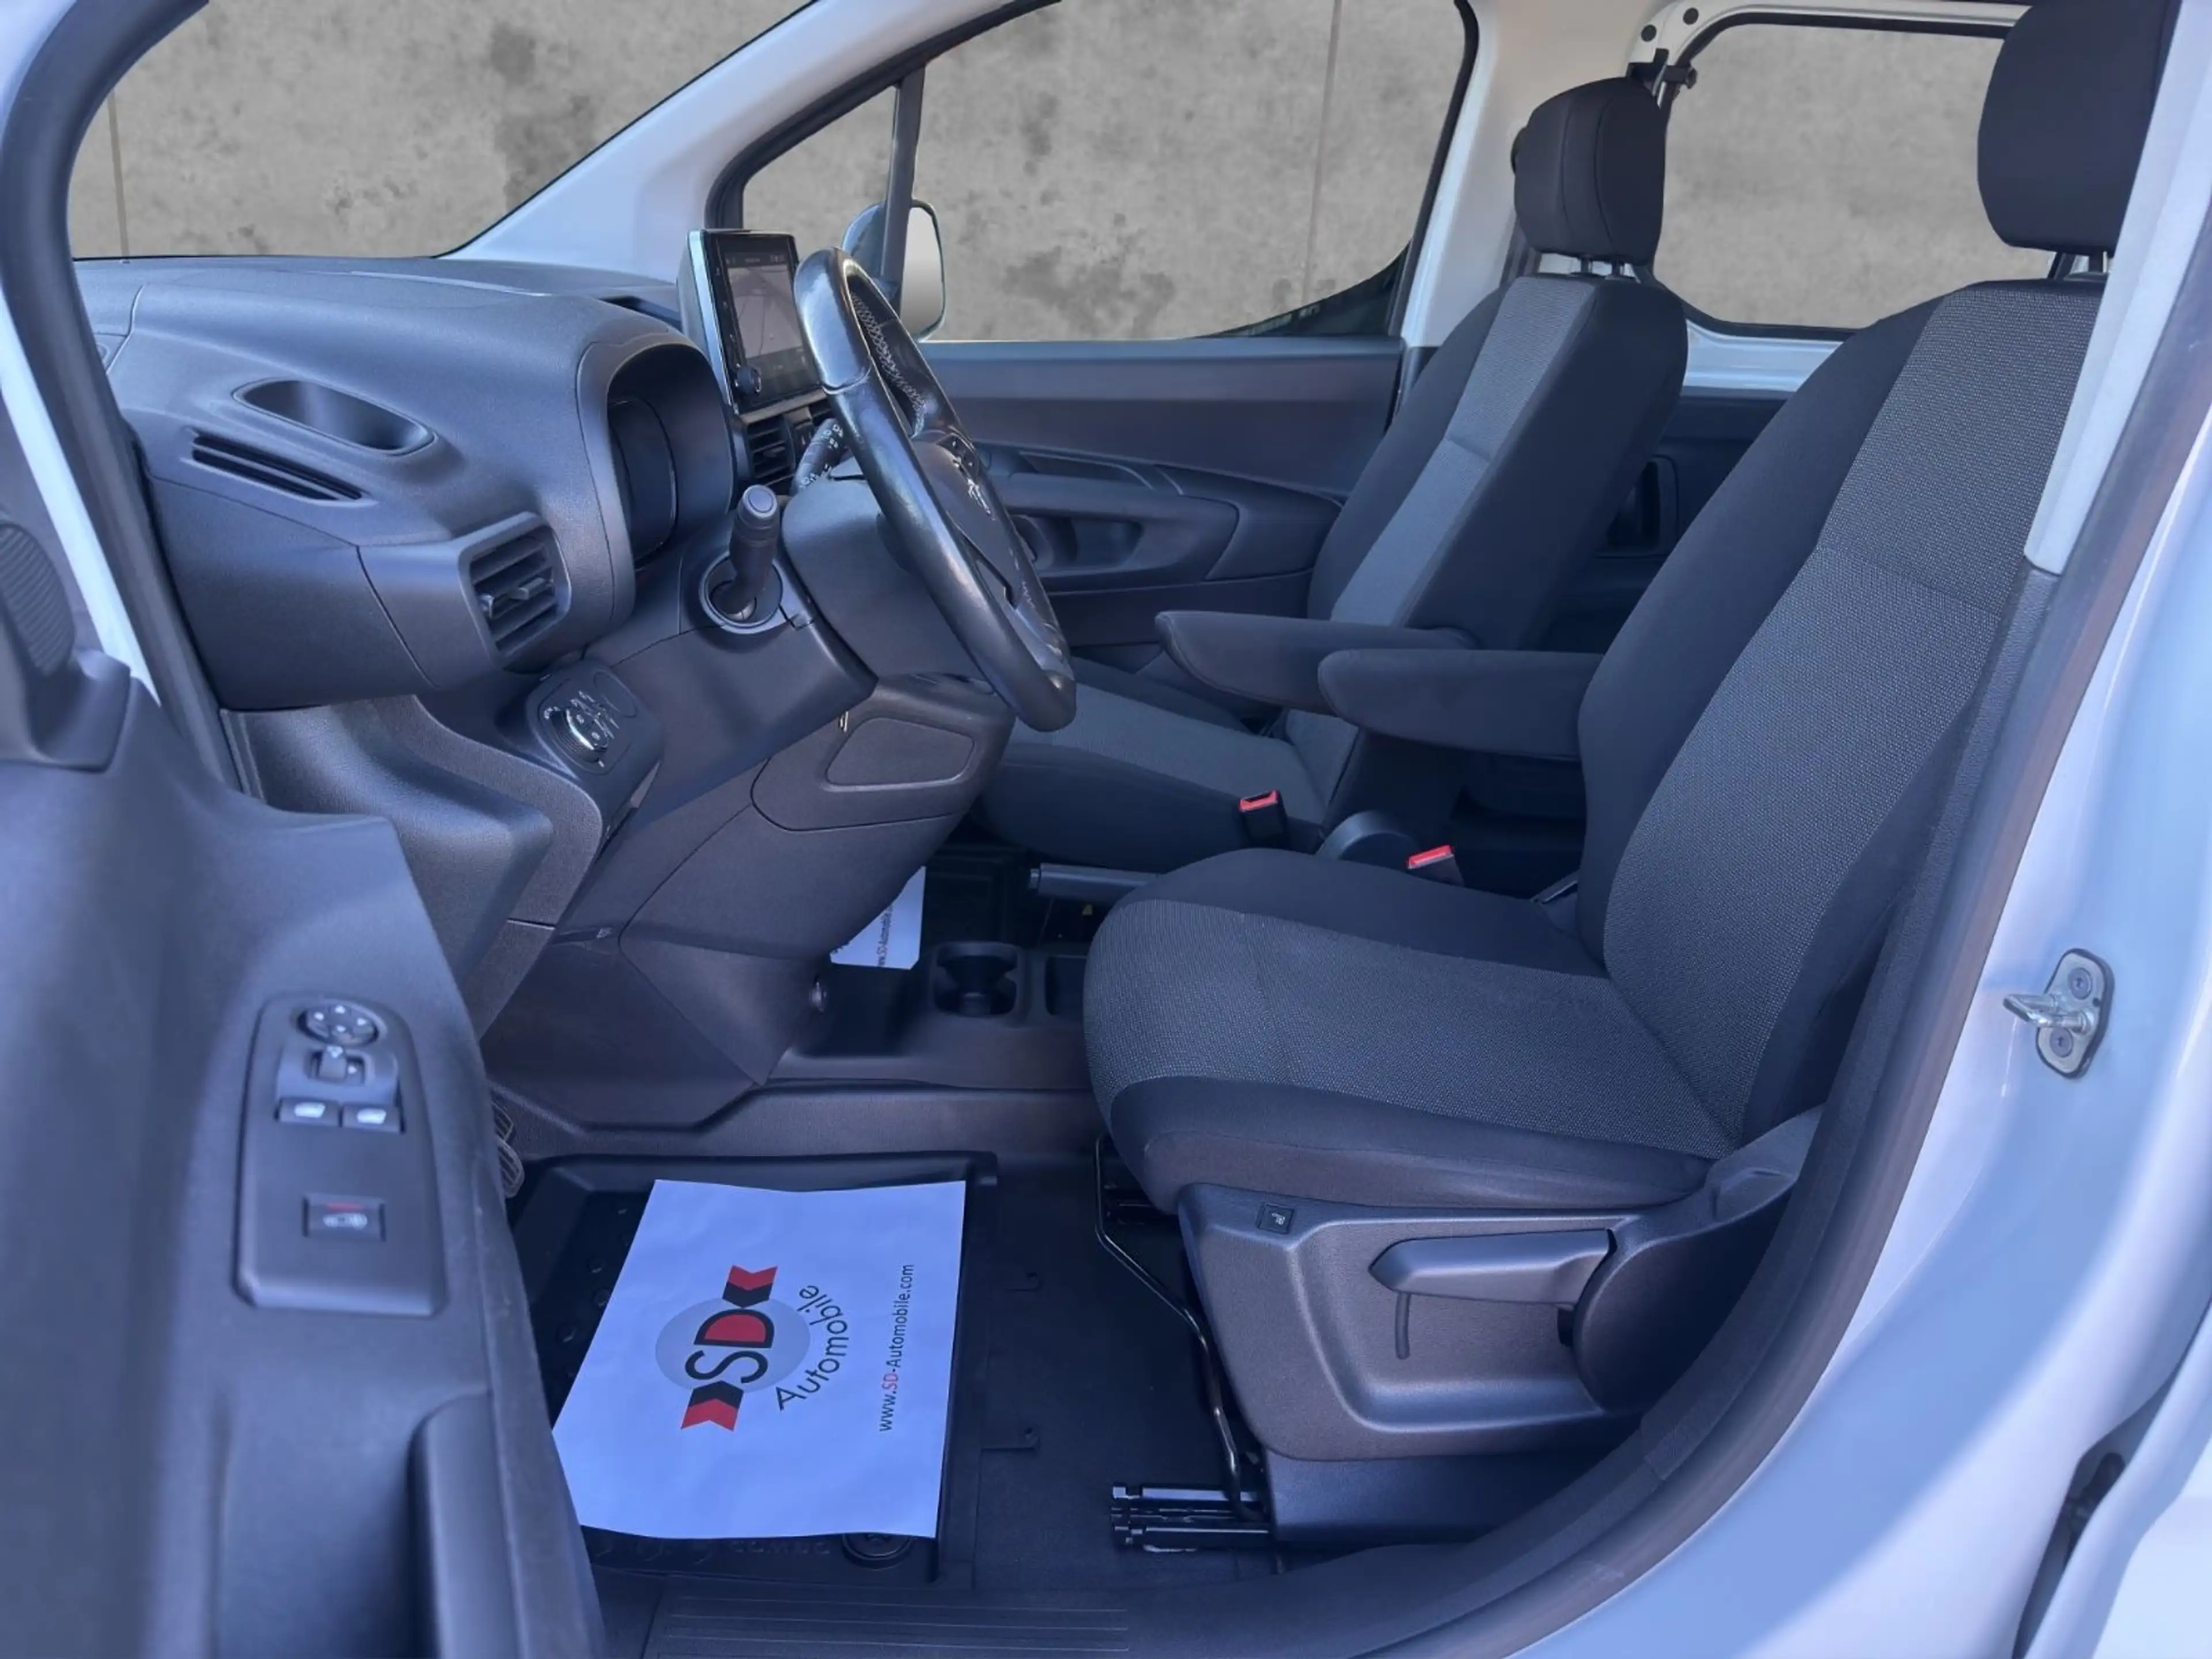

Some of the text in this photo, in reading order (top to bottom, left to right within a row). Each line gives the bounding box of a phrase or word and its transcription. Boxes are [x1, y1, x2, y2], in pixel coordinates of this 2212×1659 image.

[684, 1309, 775, 1384] SD
[775, 1285, 850, 1411] Automobile
[879, 1264, 914, 1432] www.SD-Automobile.com
